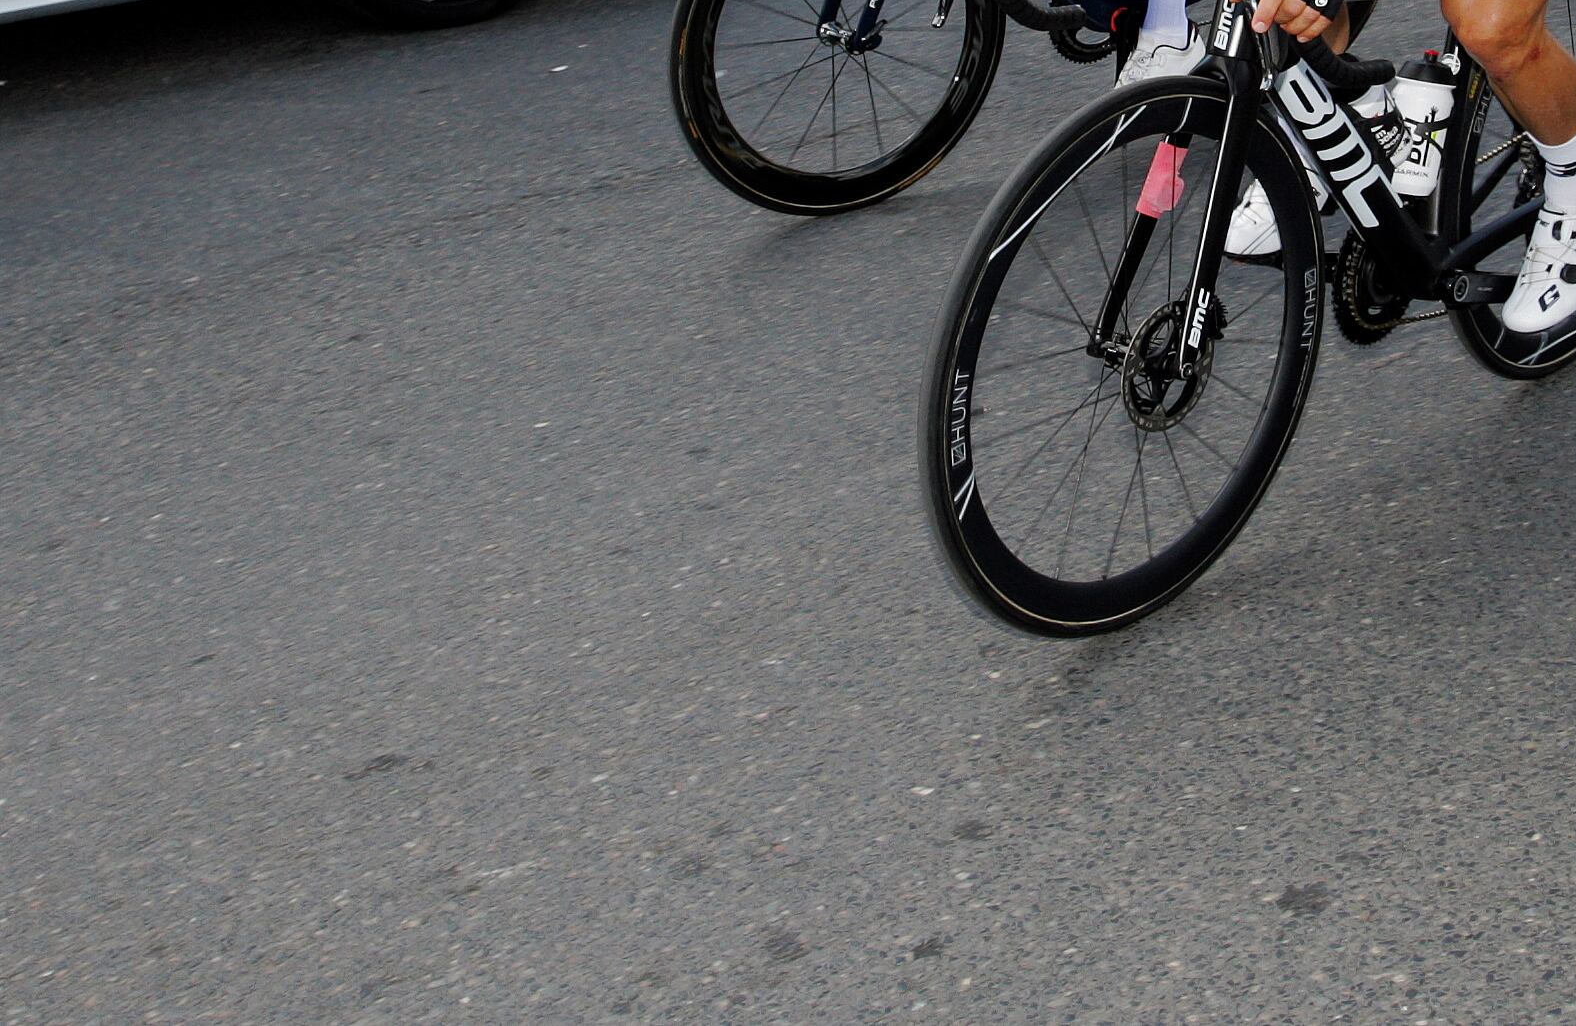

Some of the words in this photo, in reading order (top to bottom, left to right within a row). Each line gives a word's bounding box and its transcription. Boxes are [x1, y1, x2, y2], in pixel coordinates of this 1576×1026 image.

[1276, 64, 1405, 229] BMC
[1188, 288, 1211, 350] BMC
[1300, 287, 1317, 351] HUNT
[951, 369, 970, 444] HUNT
